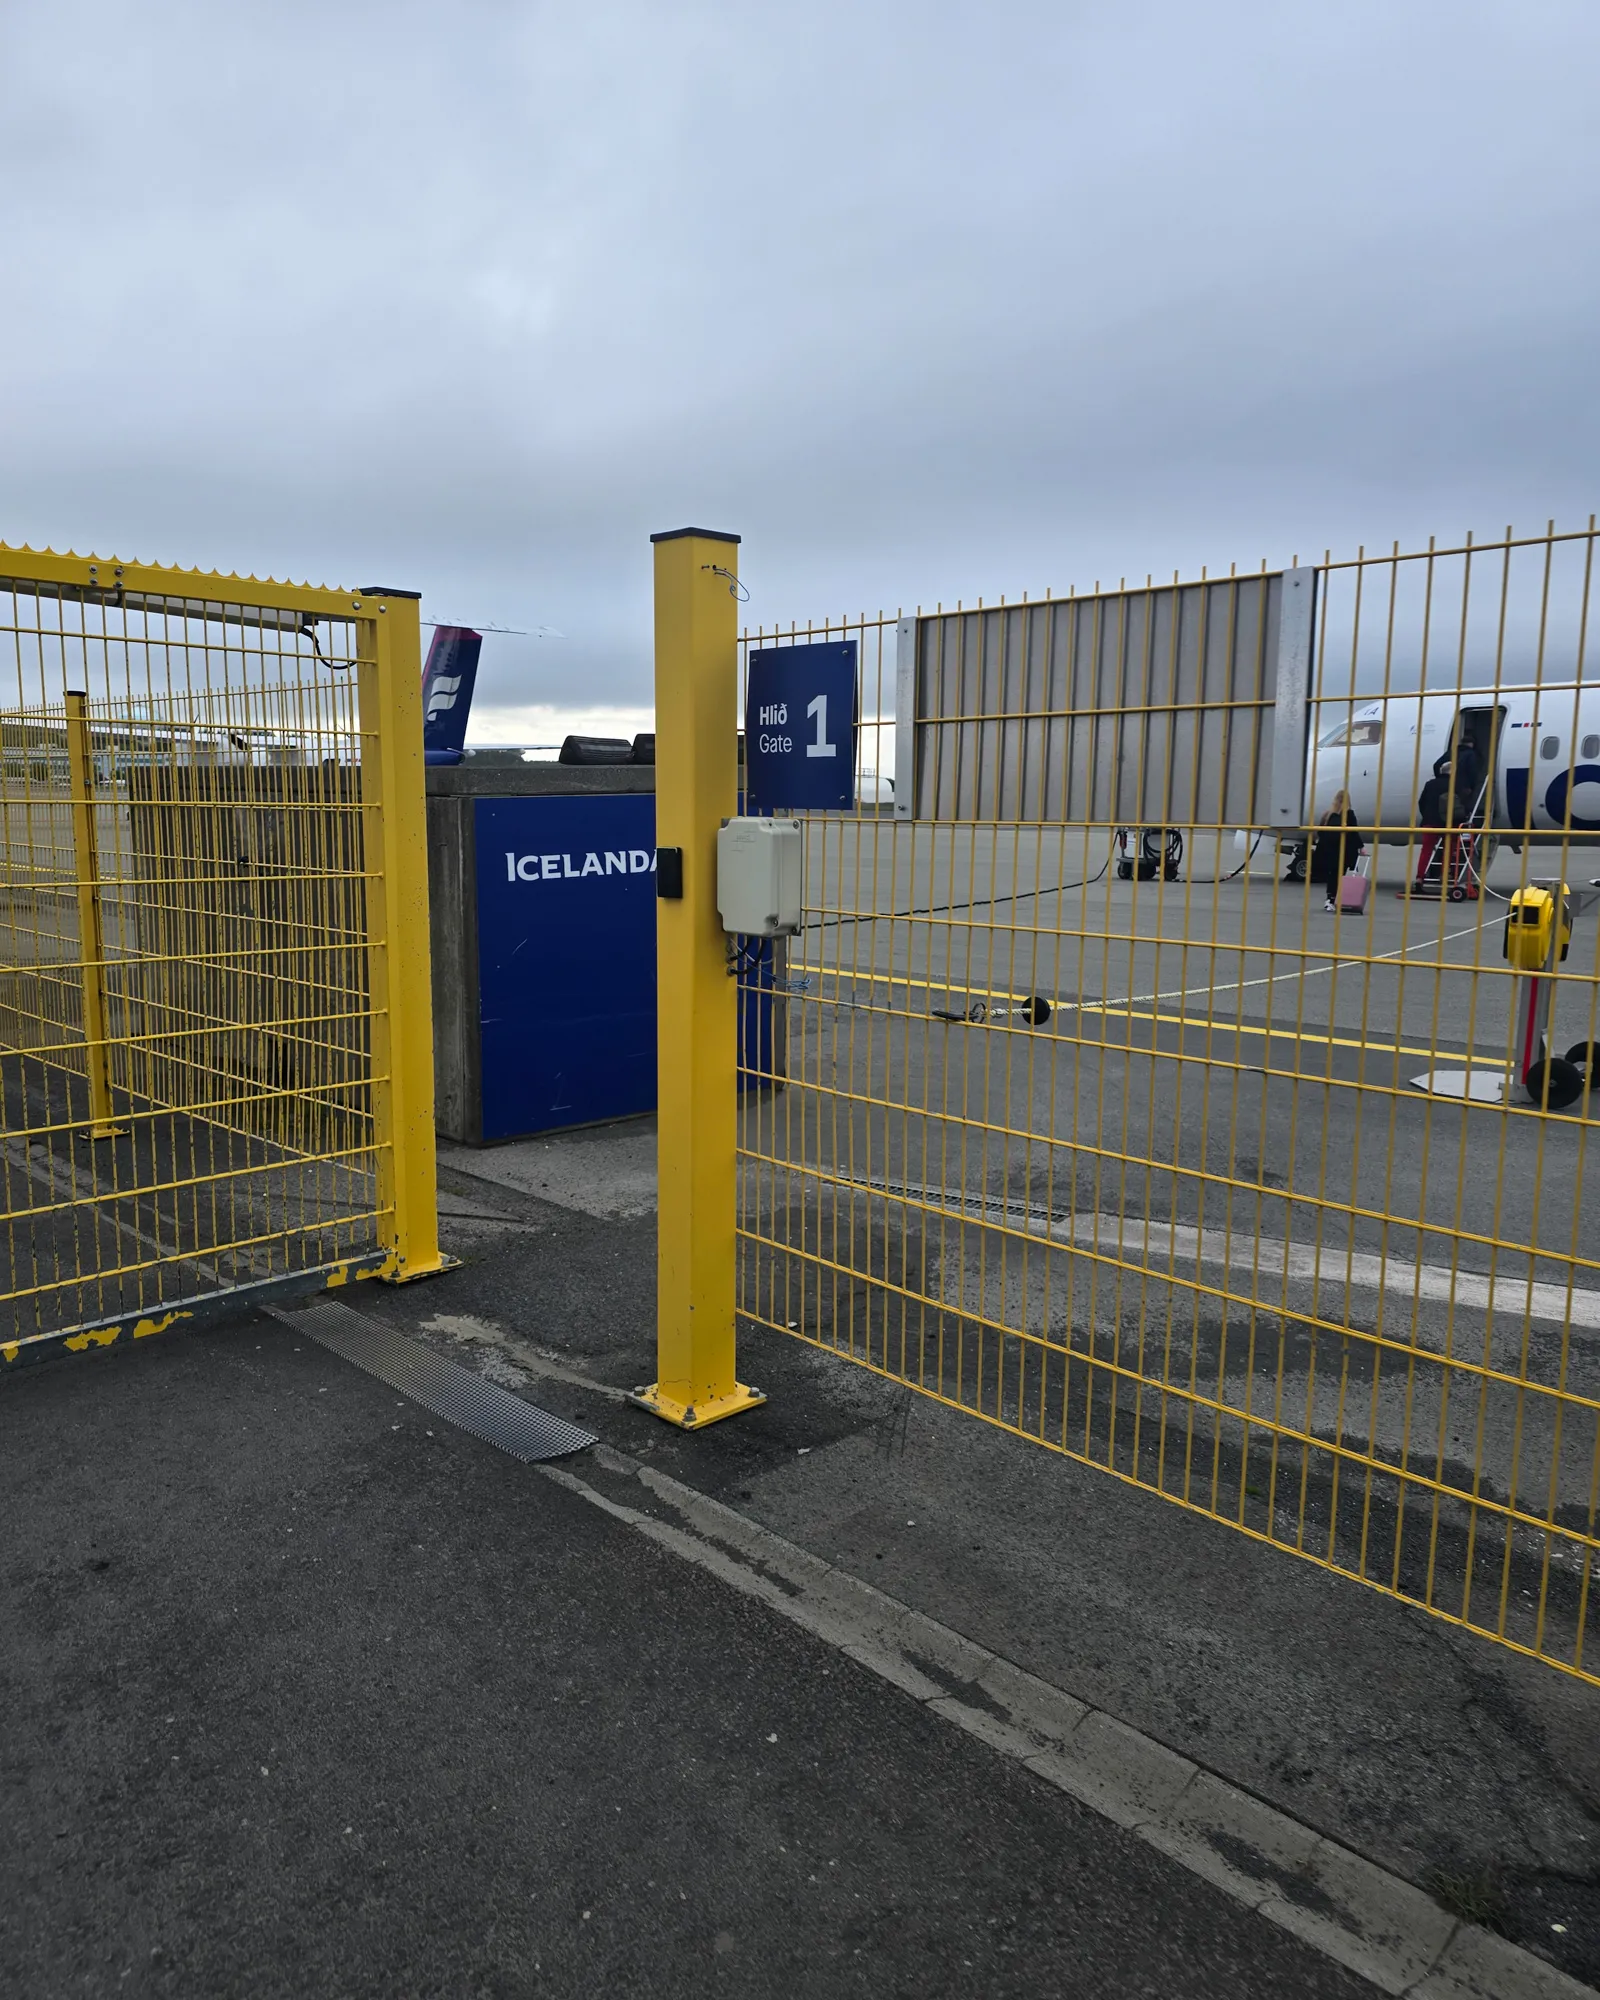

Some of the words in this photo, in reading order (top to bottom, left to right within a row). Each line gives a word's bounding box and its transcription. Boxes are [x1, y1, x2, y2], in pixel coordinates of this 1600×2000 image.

[759, 703, 788, 726] Hlið
[806, 694, 837, 758] 1
[759, 733, 793, 754] Gate
[505, 850, 657, 882] ICELAND
